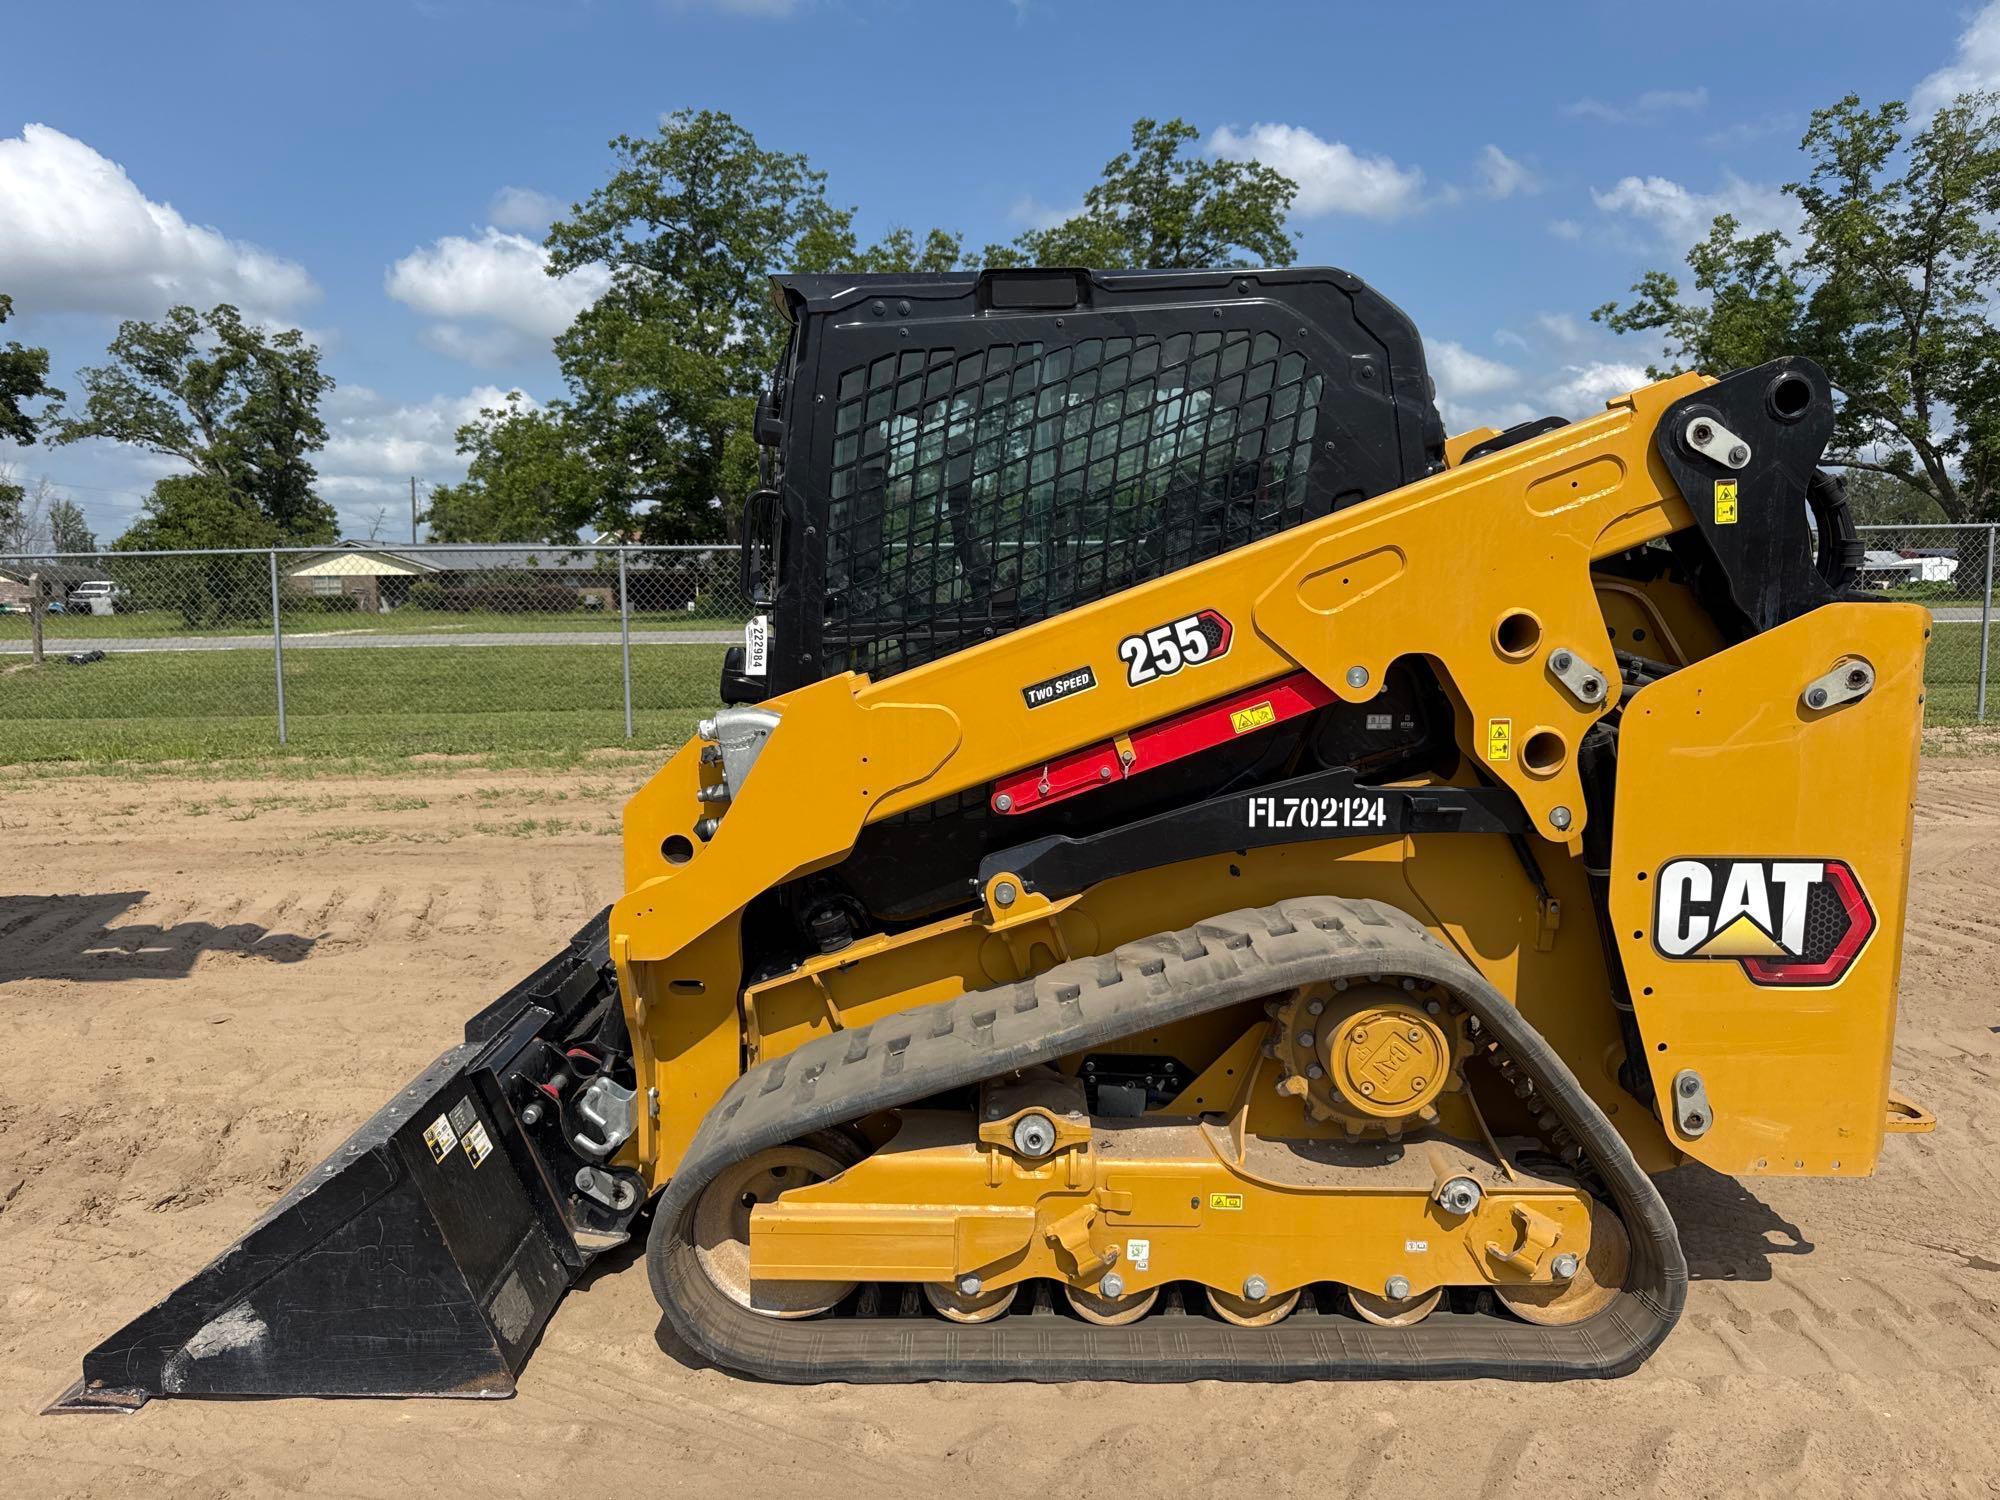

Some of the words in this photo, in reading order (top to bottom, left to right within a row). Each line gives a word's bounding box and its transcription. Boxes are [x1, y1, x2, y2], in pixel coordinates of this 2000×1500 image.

[753, 628, 764, 668] 222984
[1120, 615, 1209, 684] 255
[1248, 797, 1387, 828] FL702124
[1658, 860, 1824, 956] CAT
[1373, 1041, 1410, 1082] CAT
